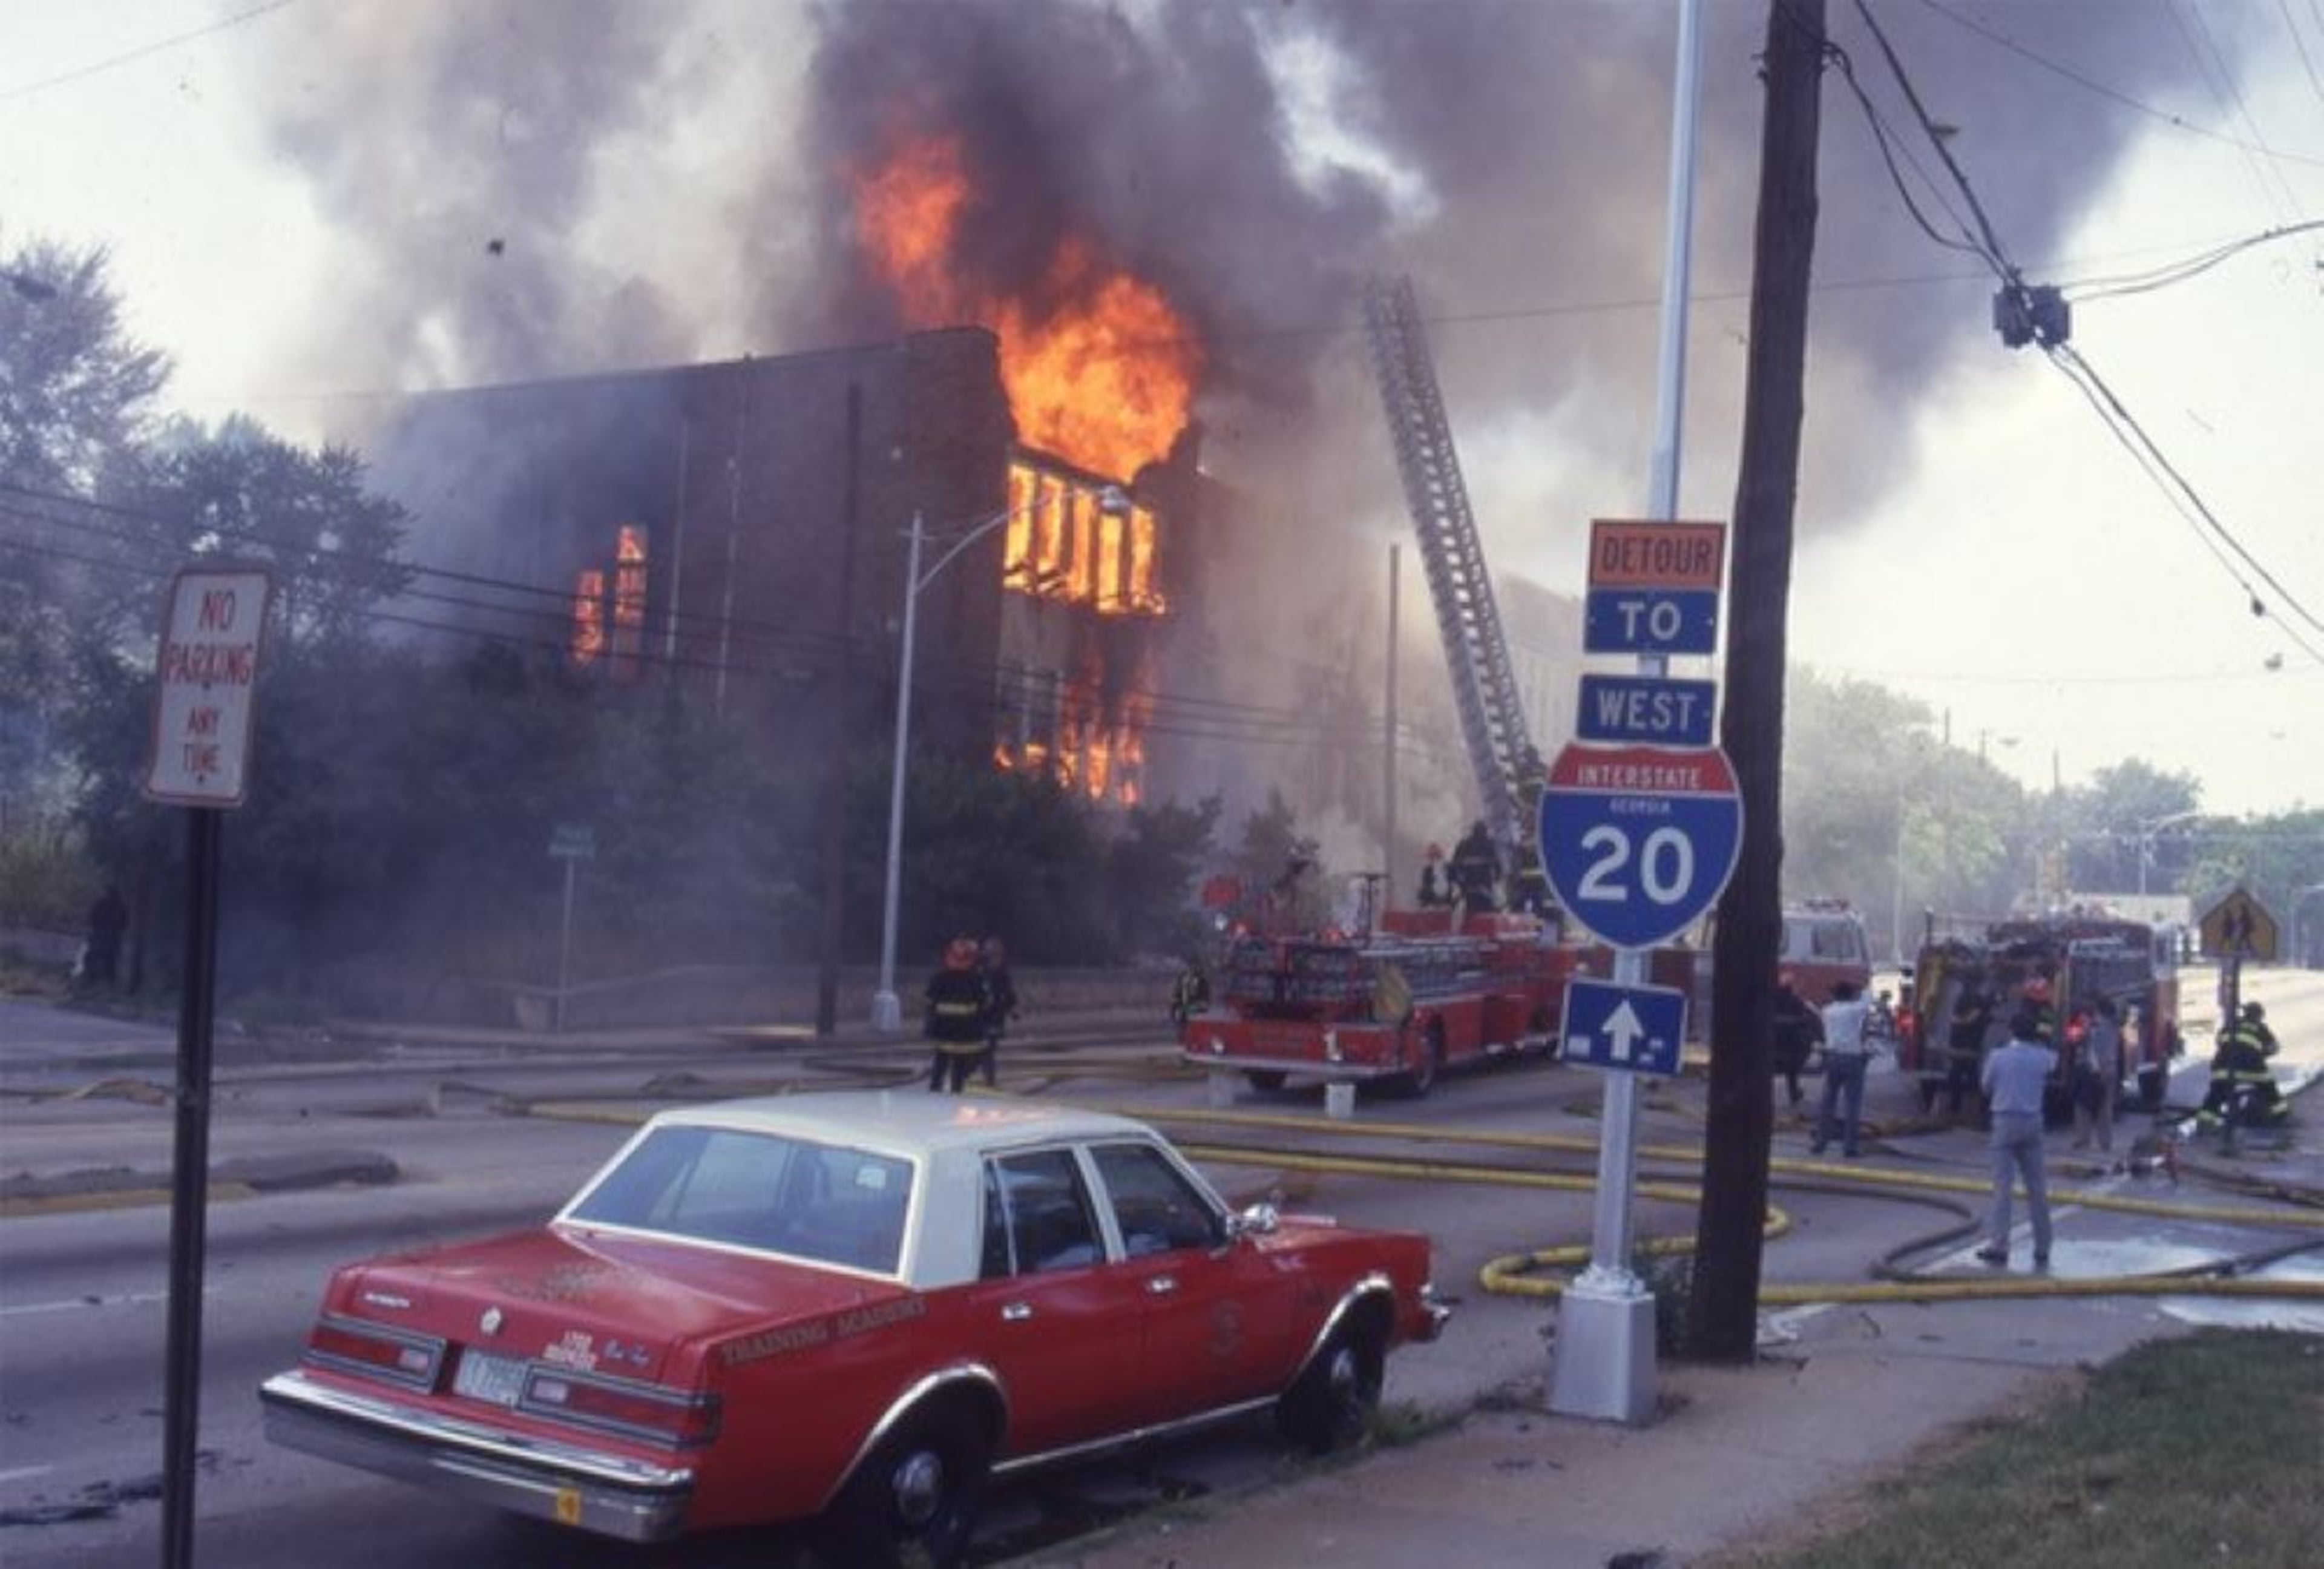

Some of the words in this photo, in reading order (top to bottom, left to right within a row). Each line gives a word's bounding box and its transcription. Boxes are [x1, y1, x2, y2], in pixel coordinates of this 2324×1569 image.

[1602, 536, 1711, 574] DETOUR
[199, 591, 235, 631] NO
[1618, 601, 1681, 640] TO
[163, 643, 252, 685] PARKING
[187, 706, 221, 735] ANY
[1597, 688, 1696, 731] WEST
[184, 743, 221, 774] TIME
[1577, 765, 1702, 789] INTERSTATE
[1577, 824, 1694, 905] 20
[721, 1320, 828, 1366] TRAINING
